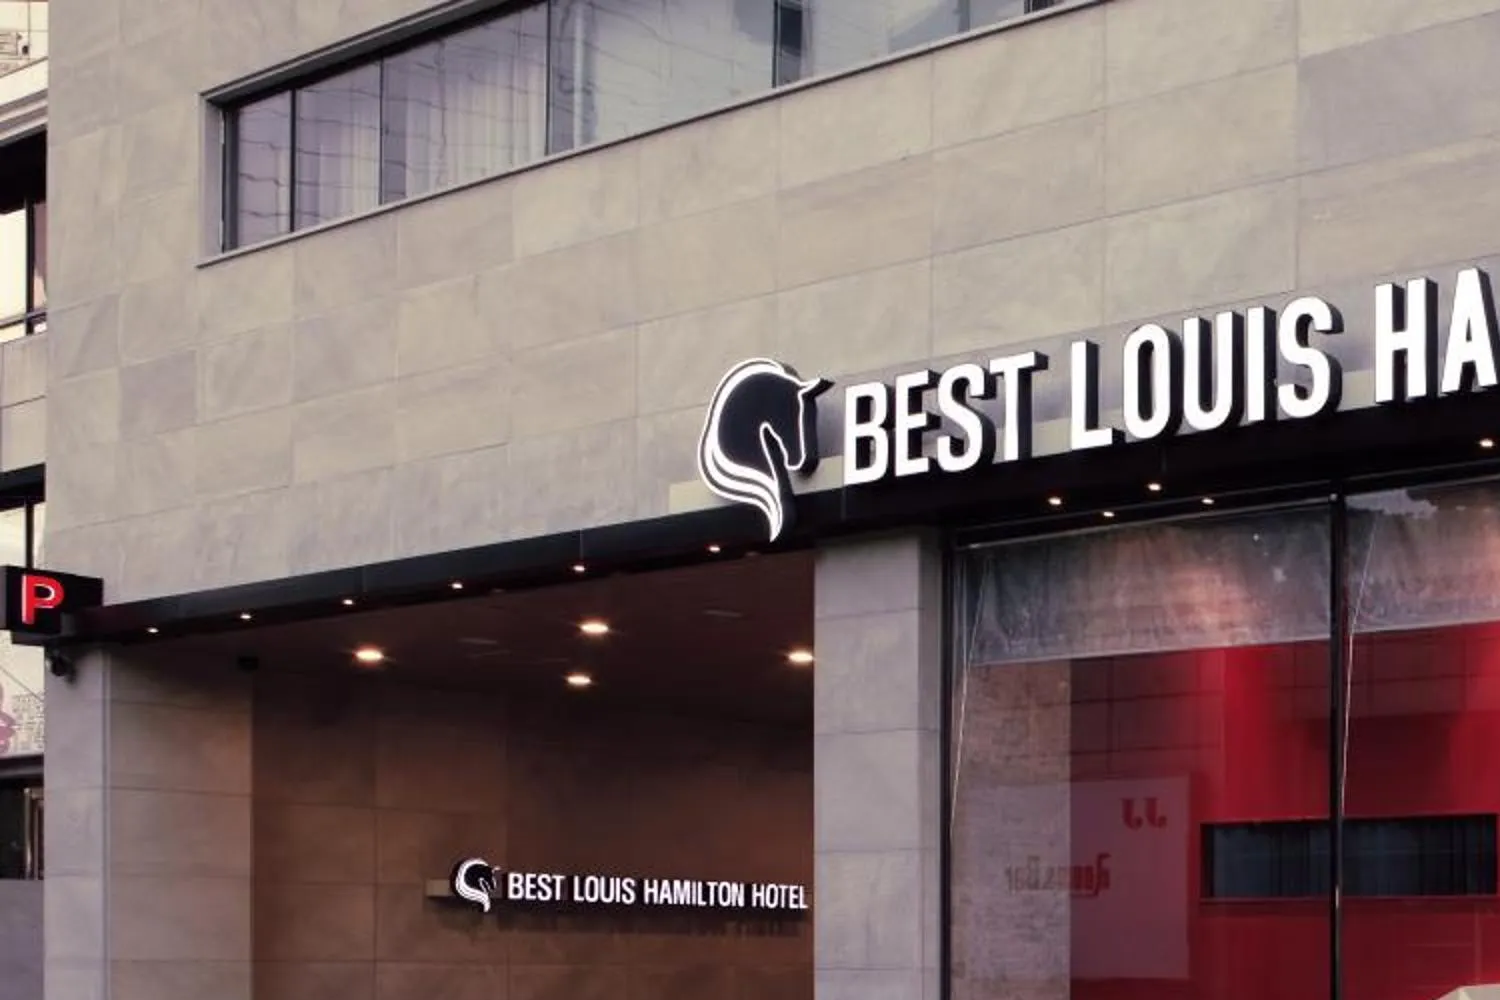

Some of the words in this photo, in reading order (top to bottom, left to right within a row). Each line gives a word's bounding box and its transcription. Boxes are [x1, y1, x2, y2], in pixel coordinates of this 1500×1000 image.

[843, 351, 1036, 486] BEST
[1070, 296, 1335, 452] LOUIS
[21, 574, 65, 625] P
[507, 872, 565, 901] BEST
[573, 875, 636, 905] LOUIS
[643, 879, 745, 907] HAMILTON
[751, 883, 809, 910] HOTEL
